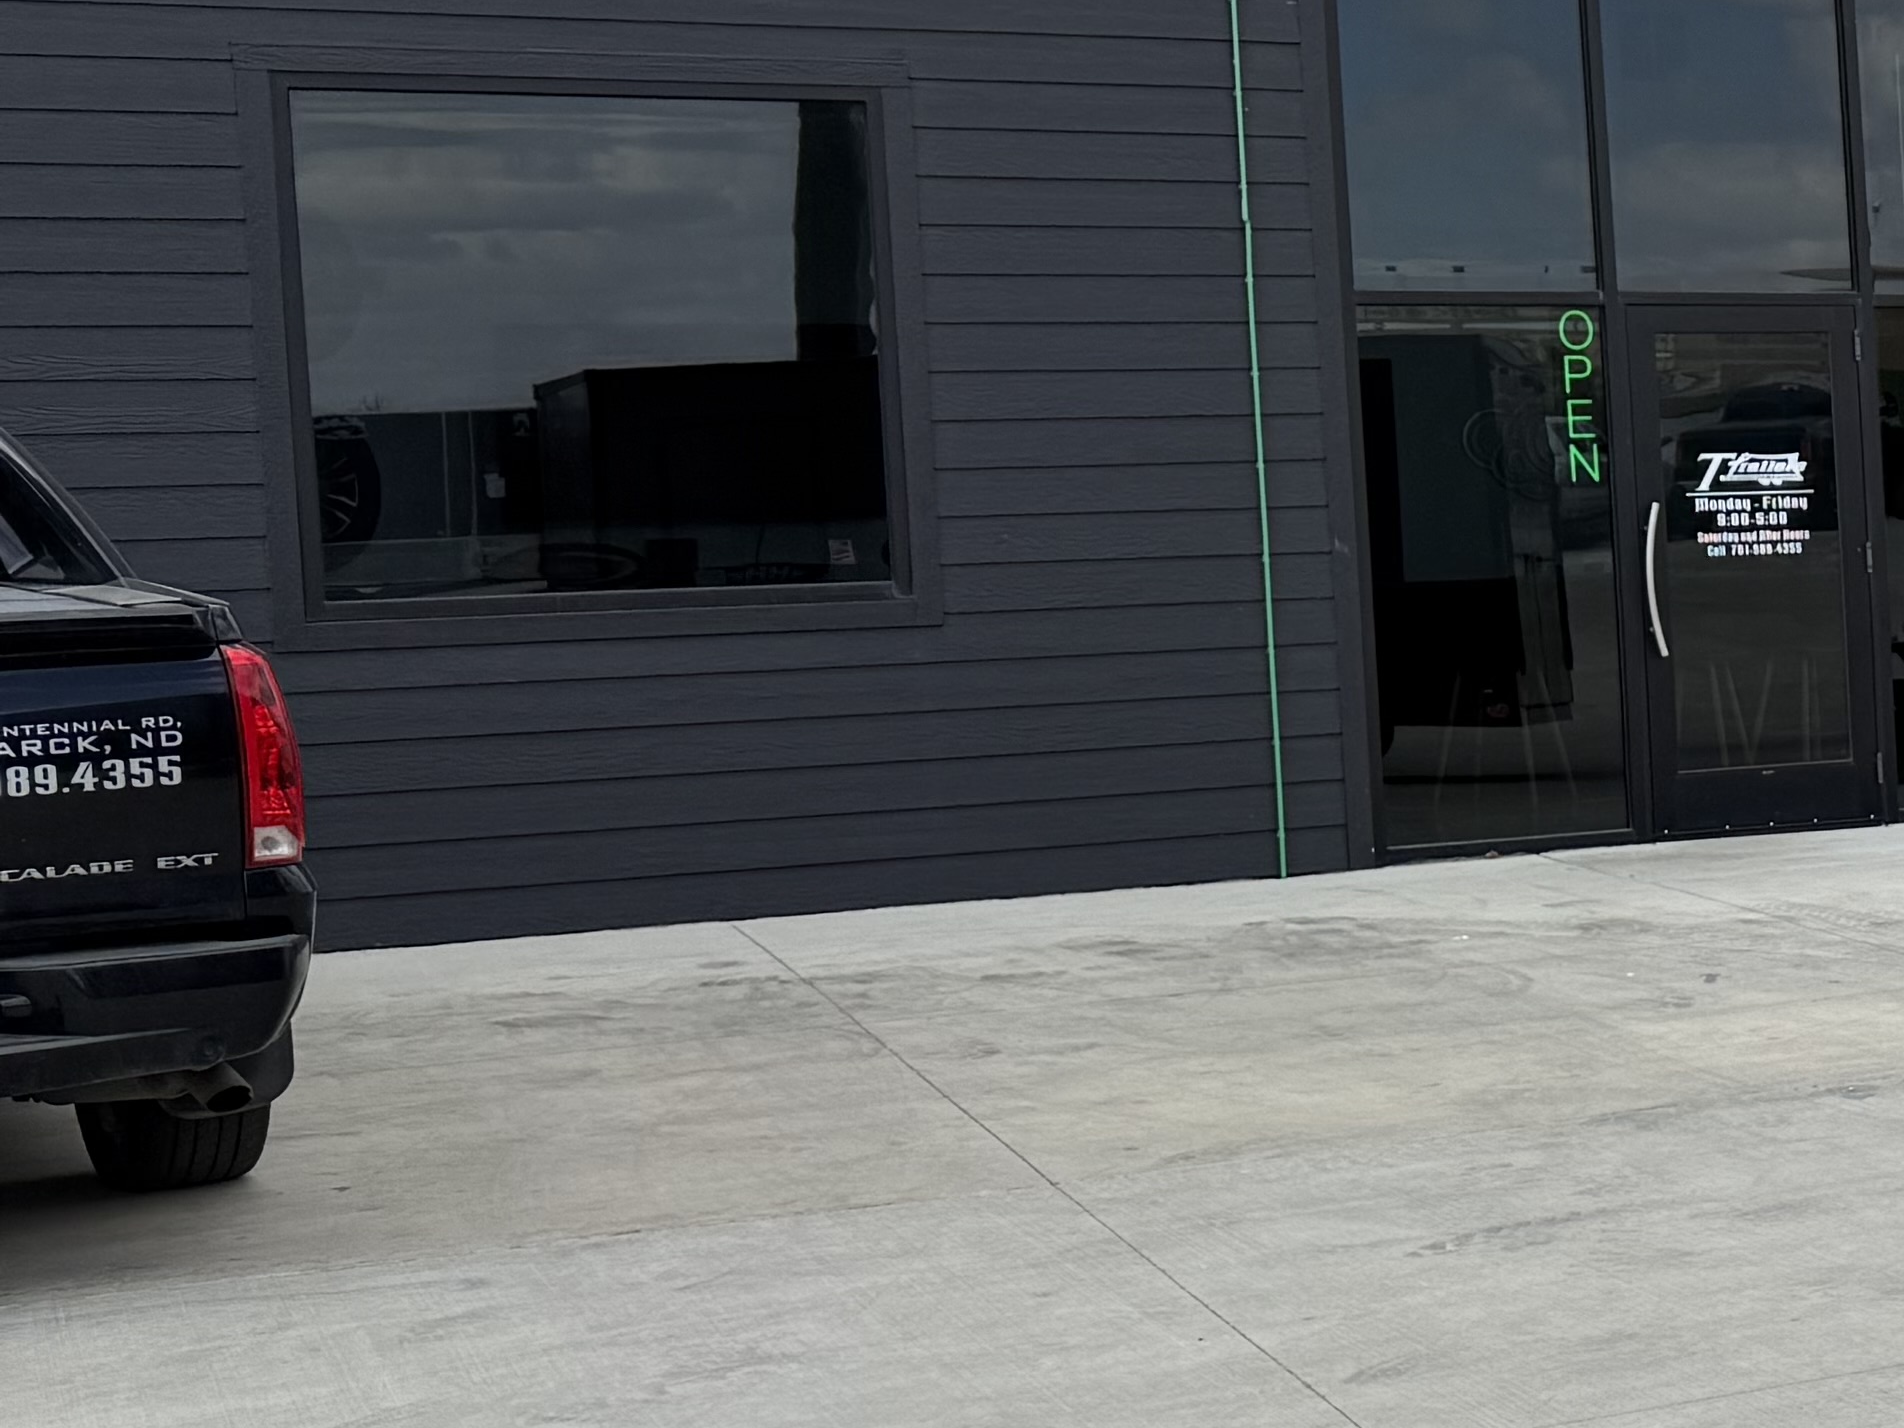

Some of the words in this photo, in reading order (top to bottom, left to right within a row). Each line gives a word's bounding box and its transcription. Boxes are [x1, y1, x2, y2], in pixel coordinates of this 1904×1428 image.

[1558, 309, 1600, 483] OPEN
[1694, 497, 1751, 512] Monday
[1762, 495, 1808, 510] Friday
[1707, 544, 1726, 557] Call
[3, 719, 131, 737] NTENNIAL
[141, 715, 182, 729] RD,
[130, 730, 183, 749] ND
[0, 755, 182, 797] 89.4355
[157, 853, 219, 869] EXT
